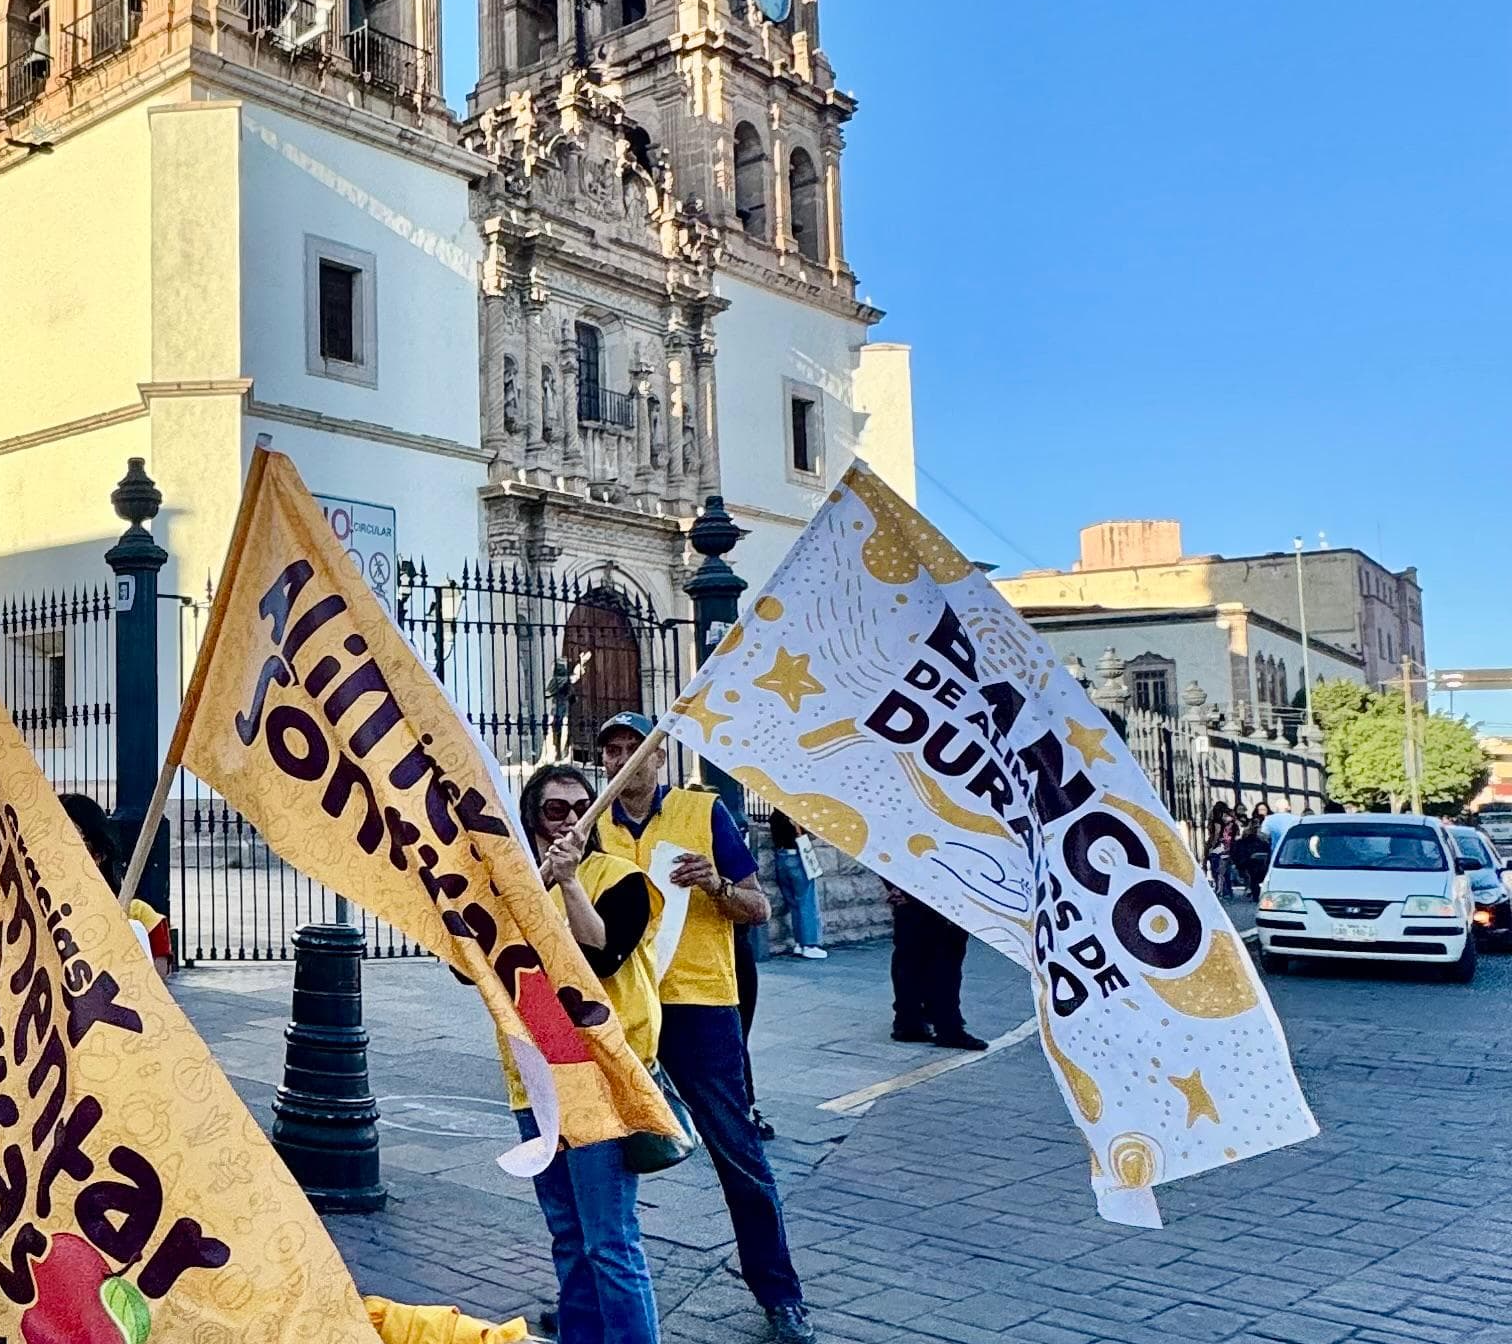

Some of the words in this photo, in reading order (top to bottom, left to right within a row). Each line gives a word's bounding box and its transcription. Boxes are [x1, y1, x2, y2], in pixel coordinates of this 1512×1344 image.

[322, 506, 350, 541] O
[353, 522, 392, 537] CIRCULAR
[903, 659, 967, 710] DE
[1068, 934, 1130, 998] DE
